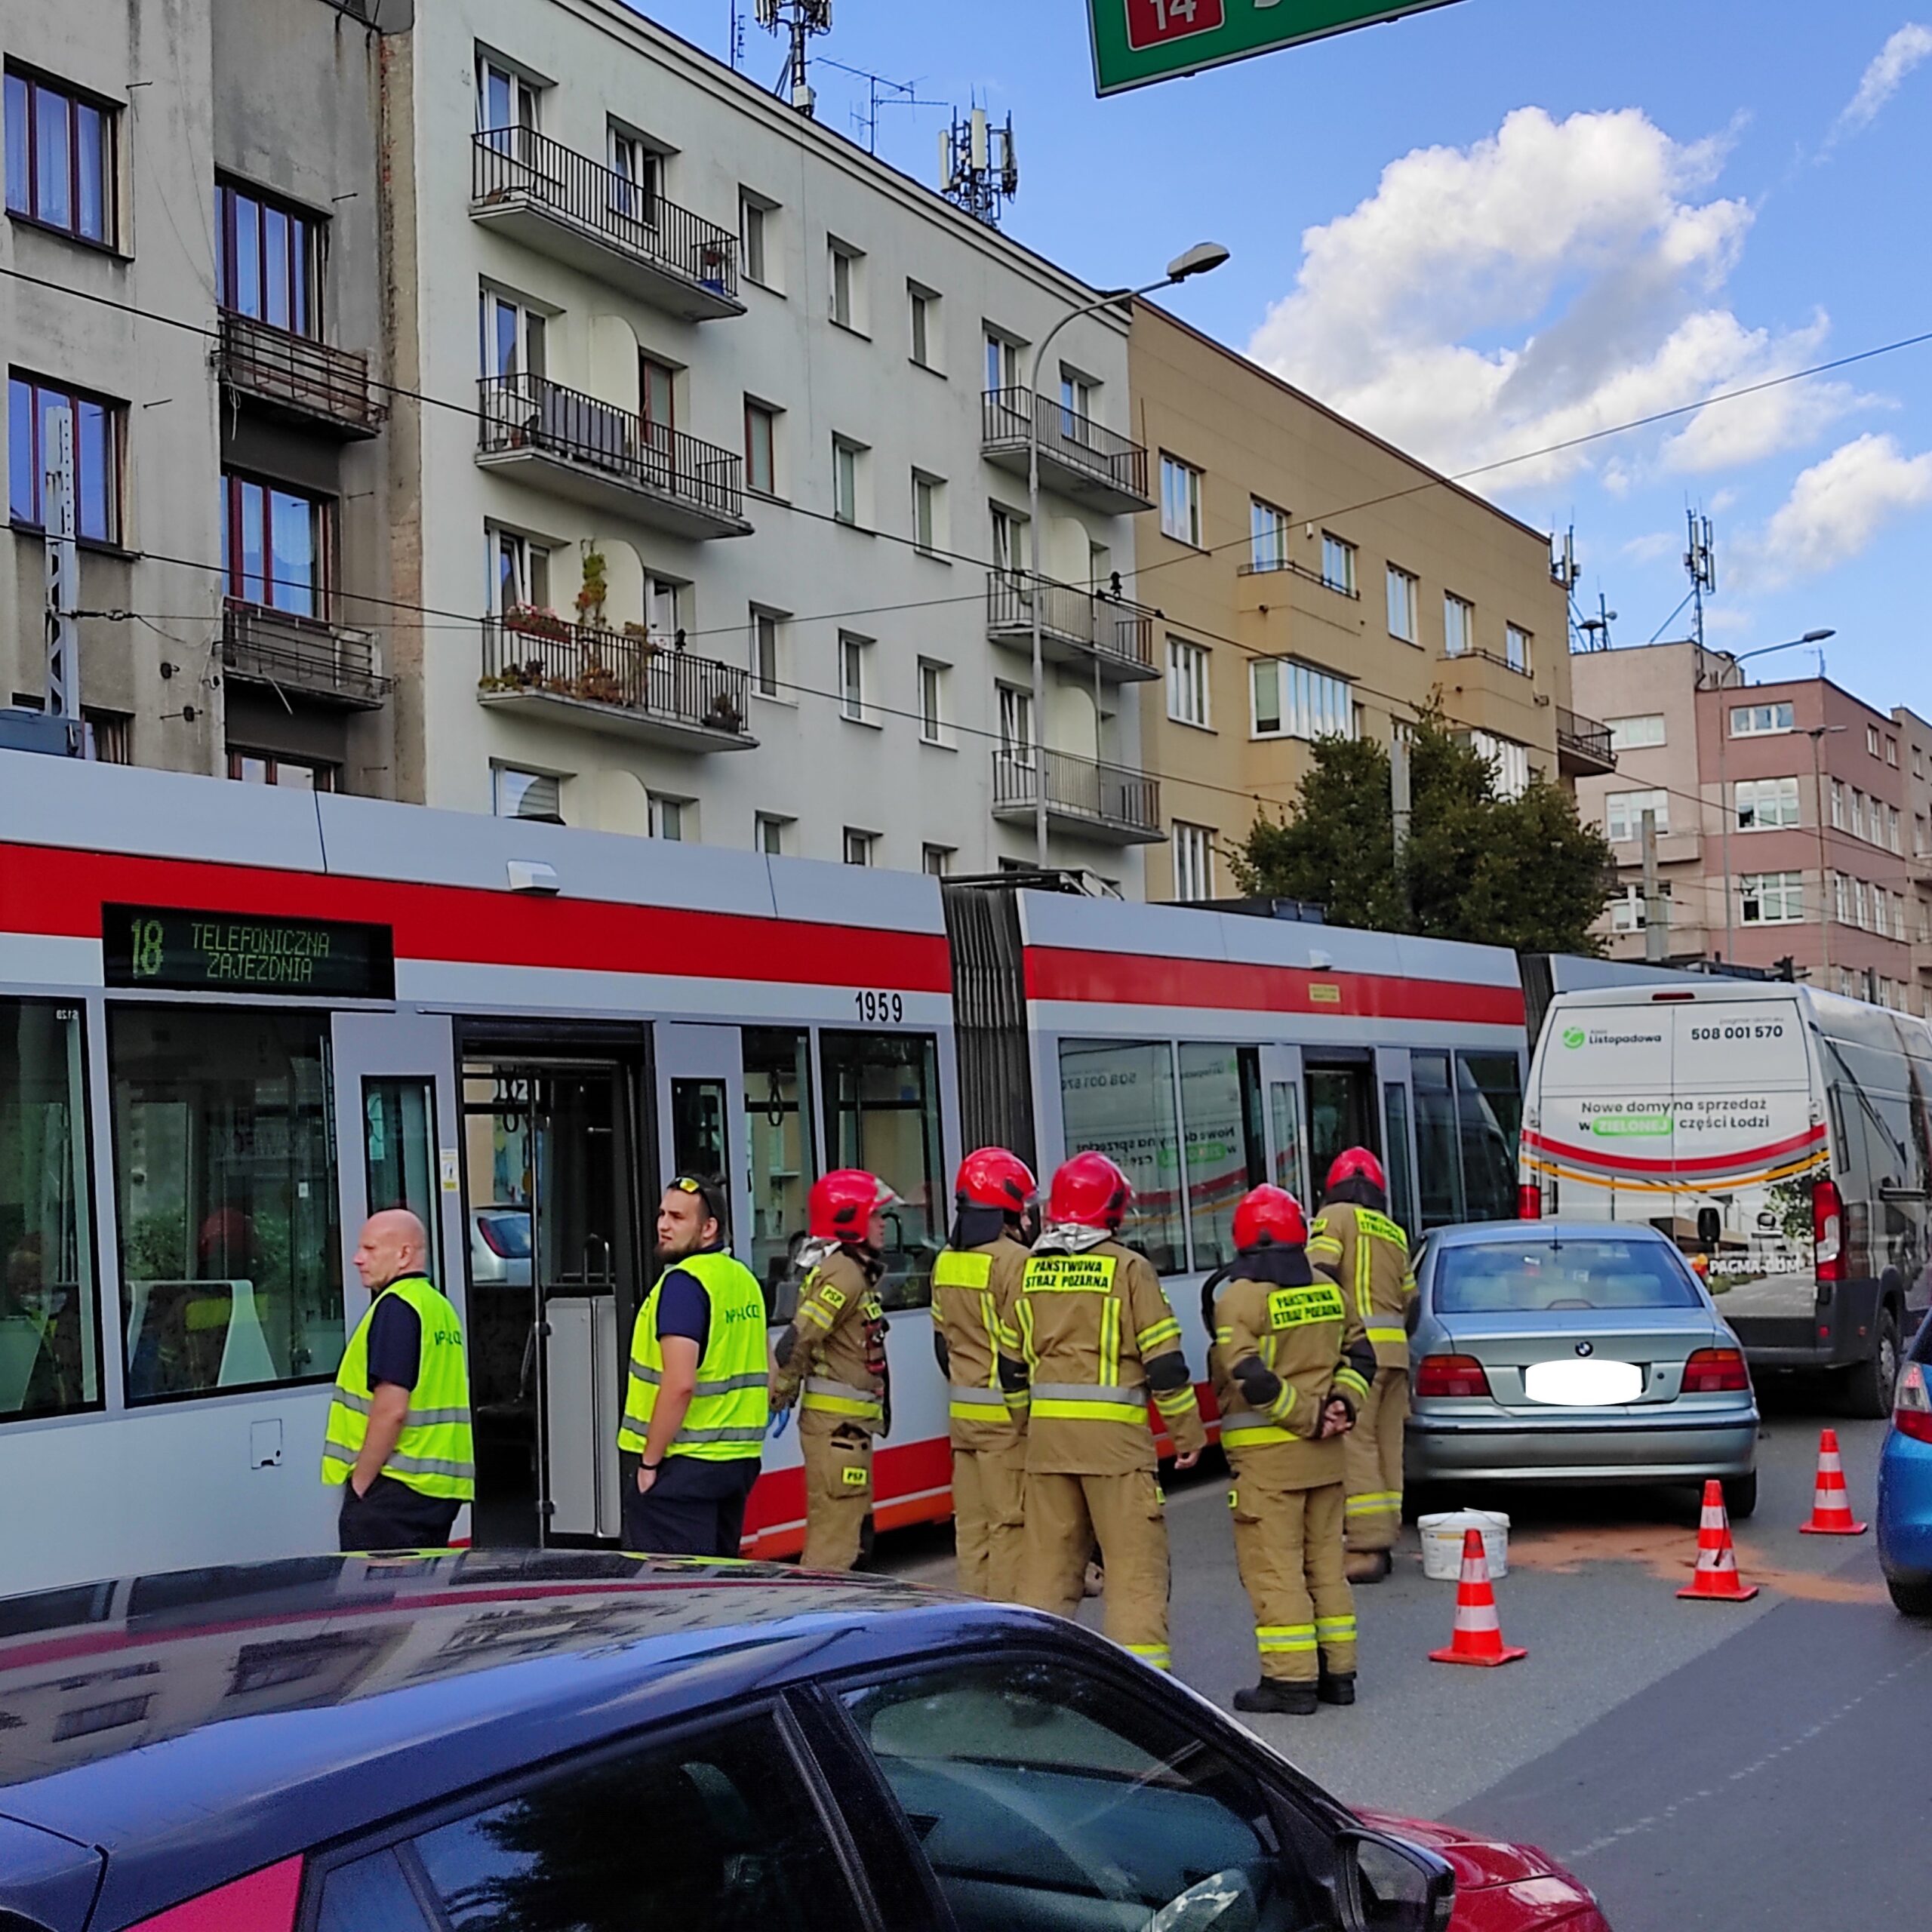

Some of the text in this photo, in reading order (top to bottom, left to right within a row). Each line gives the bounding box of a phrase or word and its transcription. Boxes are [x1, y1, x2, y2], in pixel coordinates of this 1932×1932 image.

[1149, 0, 1198, 30] 14
[131, 918, 330, 980] 18 TELEFONICZNA
[206, 952, 312, 983] ZAJEZDNIA
[855, 991, 903, 1023] 1959
[1589, 1035, 1661, 1045] Listopadowa
[1691, 1025, 1783, 1040] 508 001 570
[1582, 1097, 1767, 1116] Nowe domy na sprzedaż
[1579, 1115, 1770, 1132] w ZIELONEJ części Łodzi
